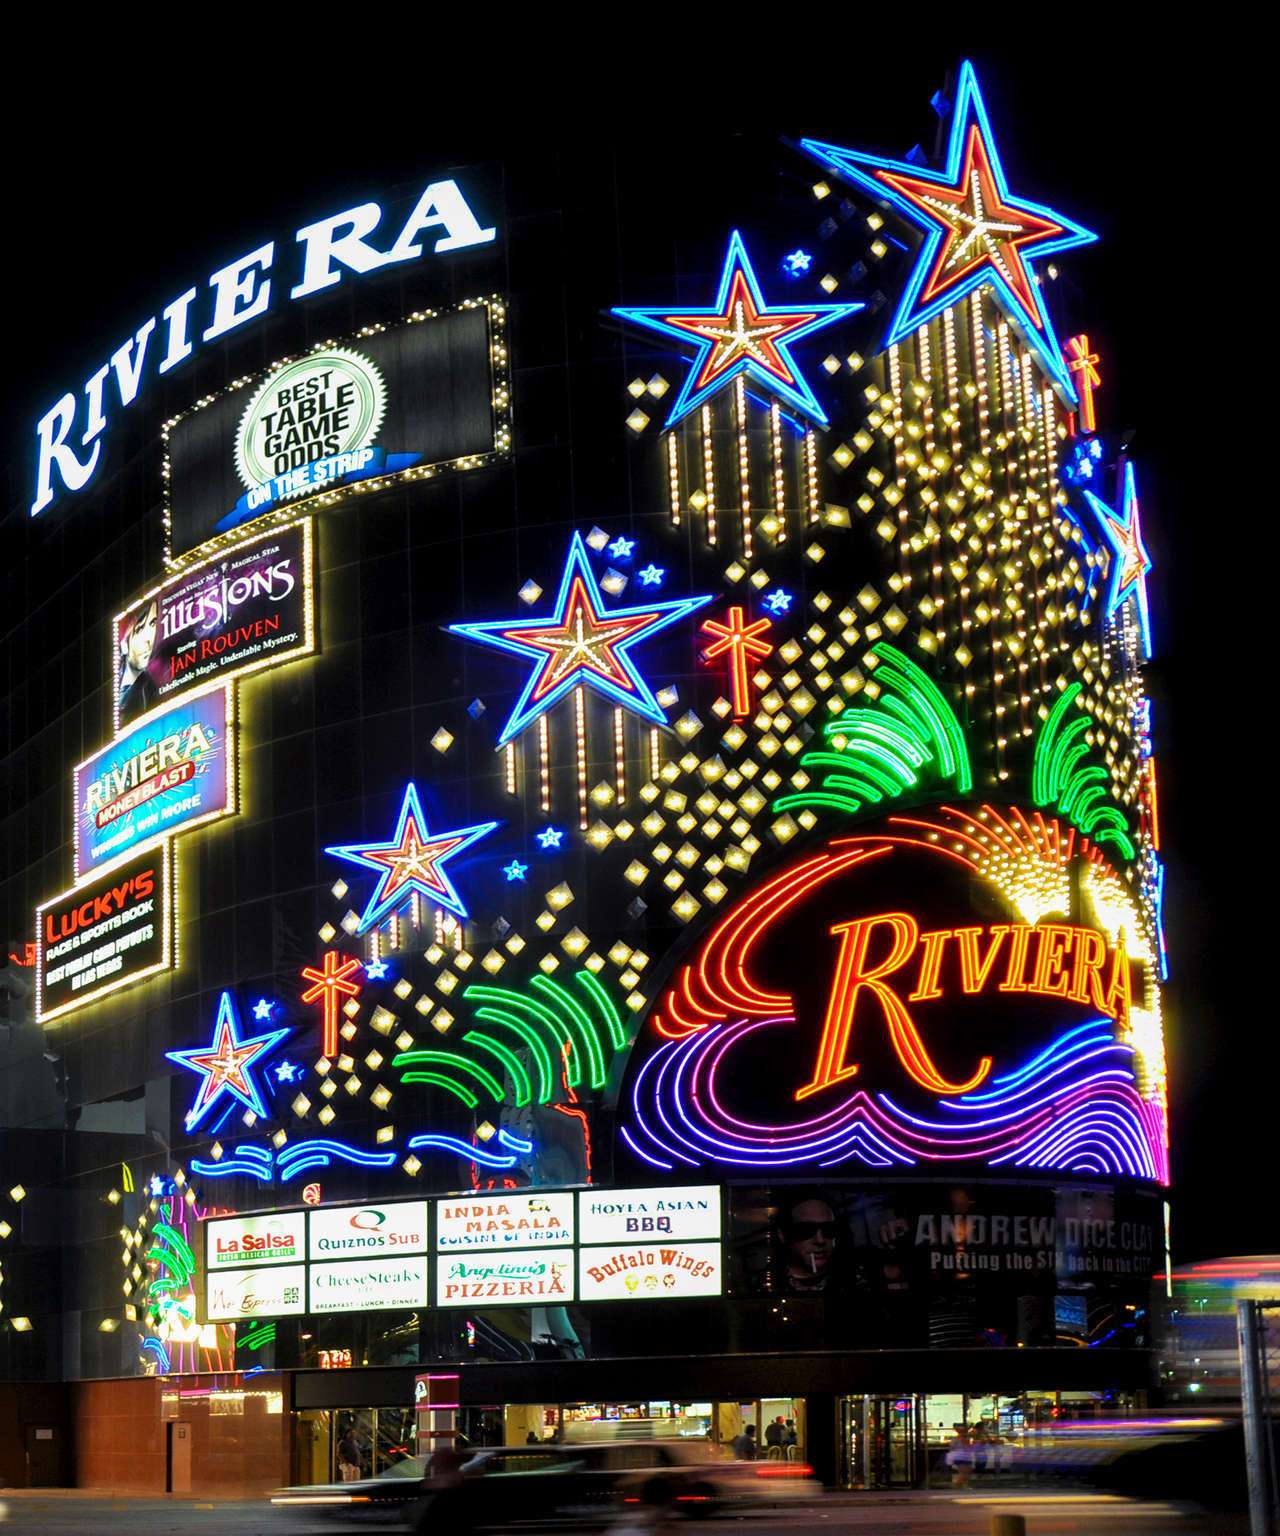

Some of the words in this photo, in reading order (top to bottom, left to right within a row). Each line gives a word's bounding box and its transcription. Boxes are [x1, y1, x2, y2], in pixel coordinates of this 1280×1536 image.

[31, 179, 496, 517] RIVIERA
[276, 370, 334, 409] BEST
[260, 381, 355, 437] TABLE
[263, 408, 350, 458] GAME
[273, 434, 341, 477] ODDS
[246, 483, 272, 510] ON
[274, 466, 310, 496] THE
[314, 448, 375, 480] STRIP
[231, 553, 261, 570] MAGICAL
[261, 545, 280, 558] STAR
[170, 649, 196, 681] JAN
[201, 614, 280, 660] ROUVEN
[220, 644, 261, 665] Undeniable
[262, 631, 298, 650] Mystery.
[84, 723, 211, 815] RIVIERA
[98, 788, 143, 826] MONEY
[141, 764, 191, 799] BLAST
[136, 812, 159, 833] WIN
[161, 794, 202, 820] MORE
[46, 869, 155, 943] LUCKY'S
[46, 939, 72, 962] RACE
[80, 915, 122, 944] SPORTS
[121, 899, 154, 925] BOOK
[794, 911, 1133, 1102] RIVIERA
[445, 1204, 510, 1219] INDIA
[656, 1199, 709, 1212] ASIAN
[439, 1233, 498, 1246] CUISINE
[504, 1232, 519, 1242] OF
[528, 1229, 570, 1241] INDIA
[466, 1216, 561, 1232] MASALA
[626, 1216, 673, 1234] BBQ
[914, 1214, 1057, 1246] ANDREW
[1064, 1217, 1117, 1250] DICE
[1120, 1221, 1153, 1251] CLAY
[216, 1237, 238, 1253] La
[242, 1232, 295, 1251] Salsa
[318, 1235, 386, 1250] Quiznos
[315, 1269, 421, 1288] CheeseSteaks
[448, 1260, 547, 1281] Angelina's
[586, 1249, 655, 1284] Buffalo
[658, 1248, 715, 1279] Wings
[930, 1251, 1000, 1271] Putting
[1006, 1252, 1033, 1270] the
[1069, 1253, 1099, 1272] back
[360, 1299, 385, 1308] LUNCH
[391, 1298, 419, 1306] DINNER
[445, 1277, 565, 1299] PIZZERIA
